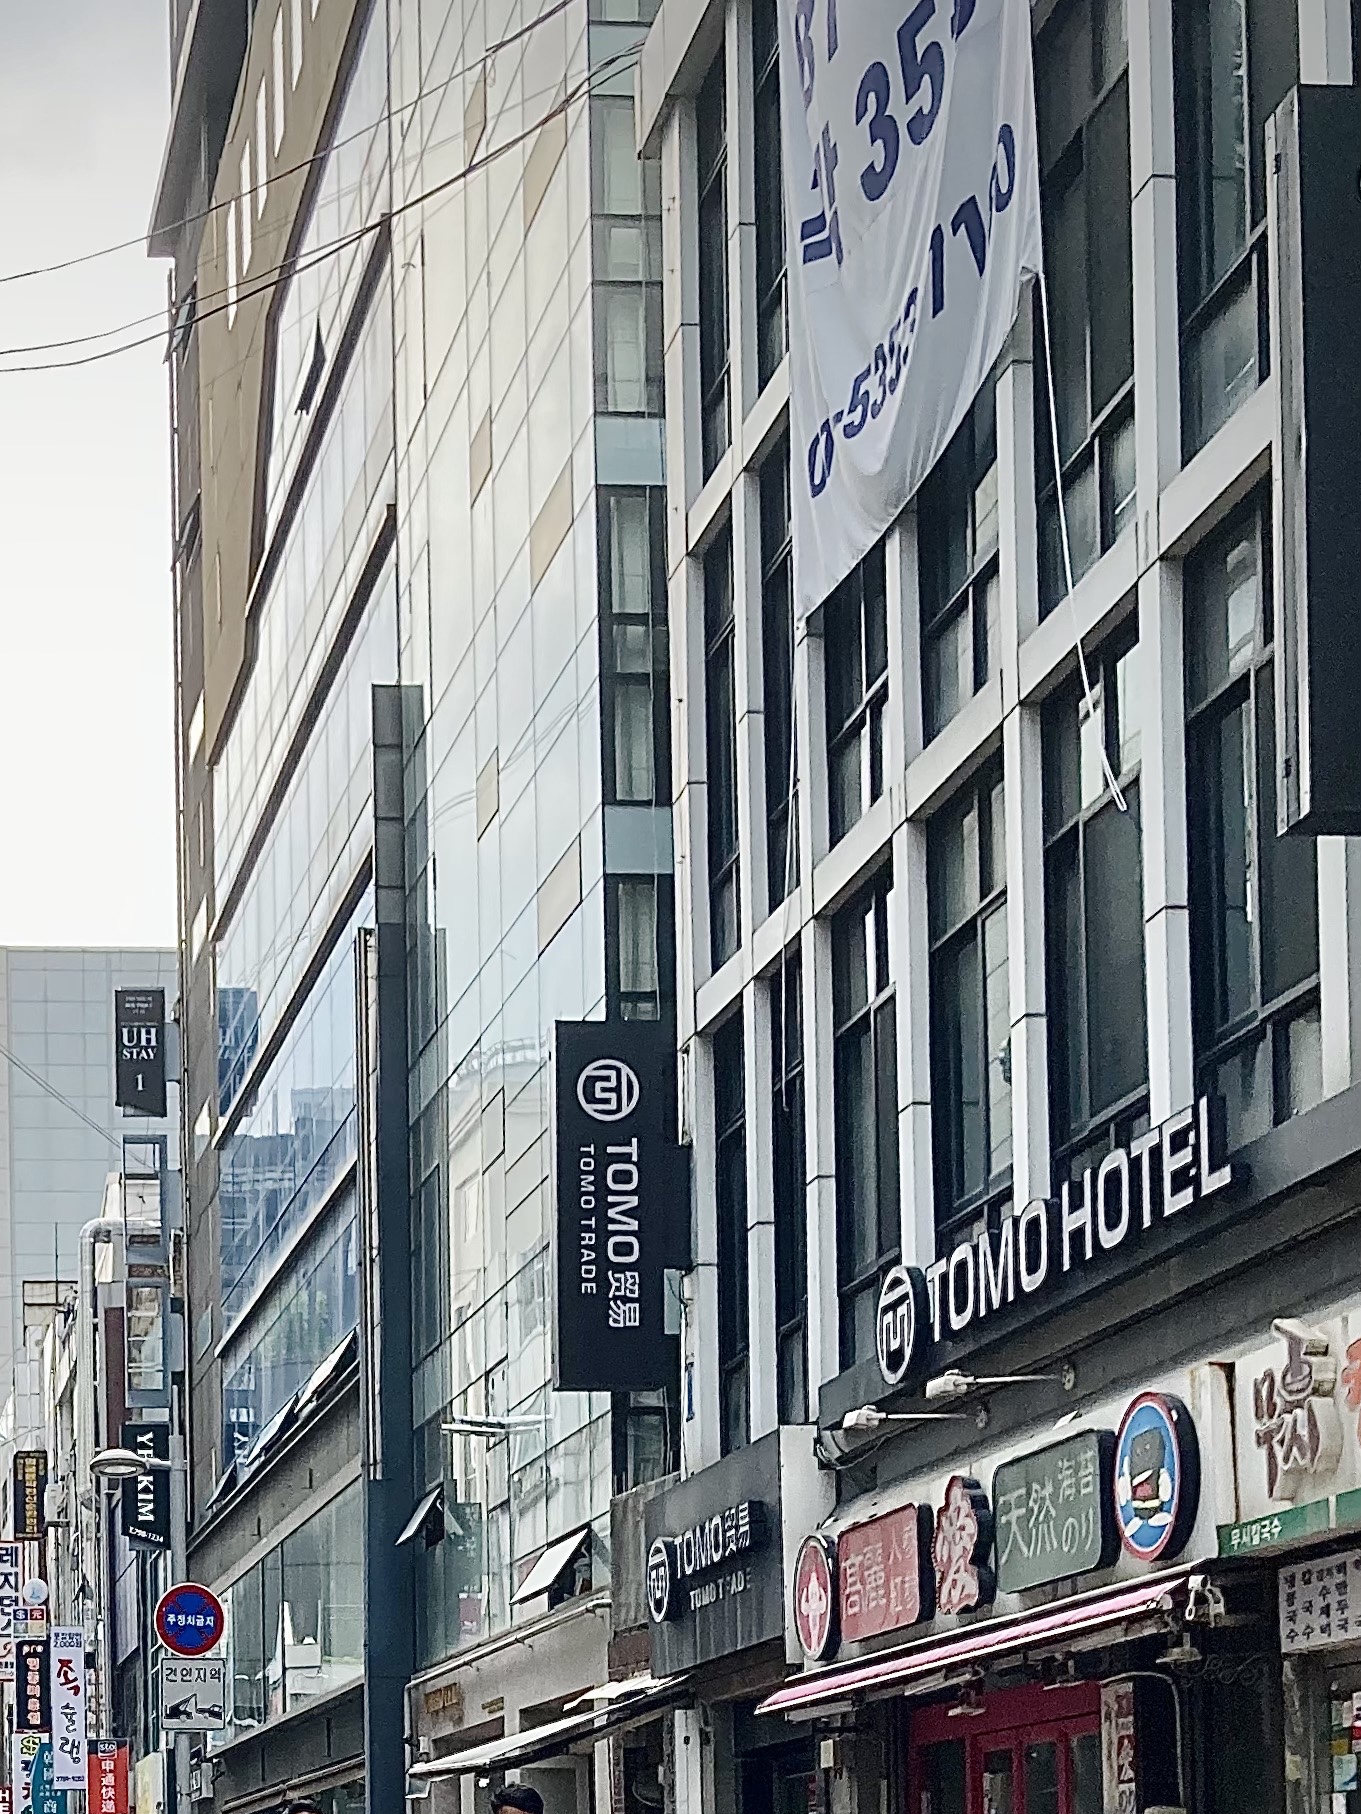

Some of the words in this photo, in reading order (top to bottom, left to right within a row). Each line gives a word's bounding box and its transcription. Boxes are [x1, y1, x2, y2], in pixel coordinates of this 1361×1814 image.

[122, 1027, 157, 1047] UH
[122, 1047, 158, 1060] STAY
[579, 1143, 596, 1209] TOMO
[606, 1138, 639, 1264] TOMO
[926, 1198, 1049, 1343] TOMO
[1061, 1094, 1232, 1272] HOTEL
[579, 1217, 597, 1295] TRADE
[673, 1513, 723, 1580] TOMO
[166, 1613, 215, 1628] 주정차금지
[165, 1666, 222, 1684] 견인지역
